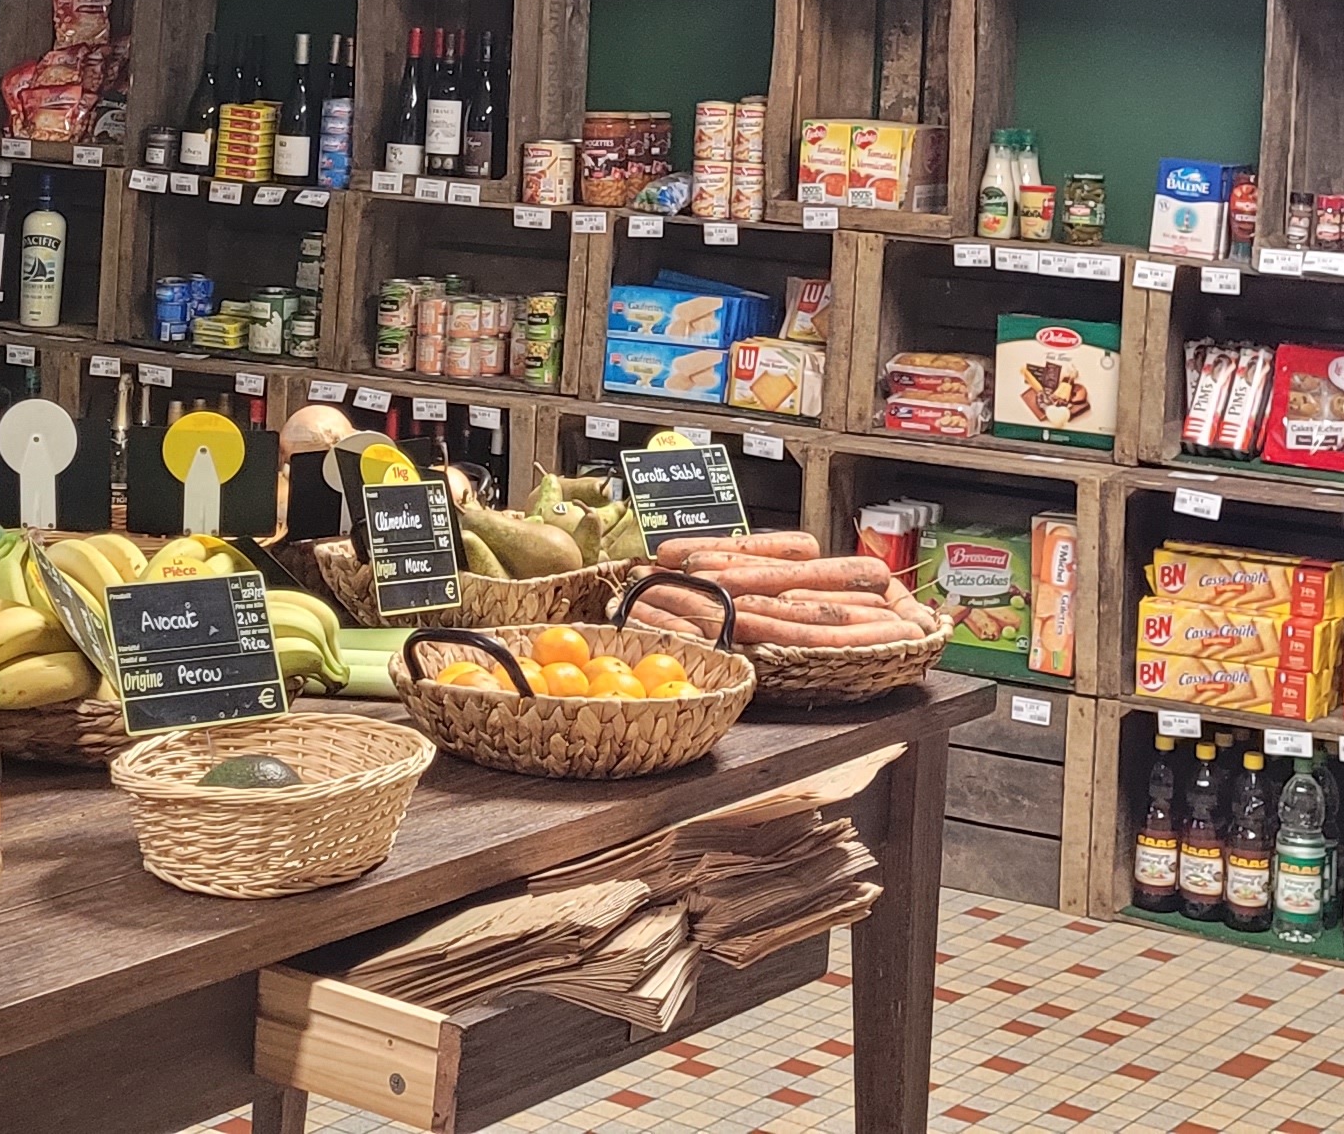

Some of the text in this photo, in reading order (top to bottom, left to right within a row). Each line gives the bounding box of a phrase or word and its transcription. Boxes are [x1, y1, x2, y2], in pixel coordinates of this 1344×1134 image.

[1166, 177, 1210, 194] BALEINE
[22, 236, 61, 249] PACIFIC
[802, 283, 823, 304] LU
[737, 348, 755, 371] LU
[1290, 423, 1314, 434] Cakes
[655, 435, 677, 447] 1kg
[392, 467, 409, 482] 1kg
[631, 467, 671, 484] Carotte
[641, 509, 710, 529] Origine France
[173, 558, 183, 566] La
[376, 558, 432, 579] Origine Maroc
[162, 565, 198, 579] Pièce
[946, 573, 1009, 587] Petits Cakes
[1159, 563, 1187, 589] BN
[1198, 573, 1228, 587] Casse
[444, 581, 456, 600] €
[140, 609, 200, 633] Avocat
[236, 611, 259, 626] 2,10
[1144, 615, 1172, 639] BN
[1184, 626, 1213, 639] Casse
[123, 664, 223, 692] Origine Perou
[1139, 660, 1166, 686] BN
[1178, 672, 1207, 686] Casse
[258, 687, 277, 709] €
